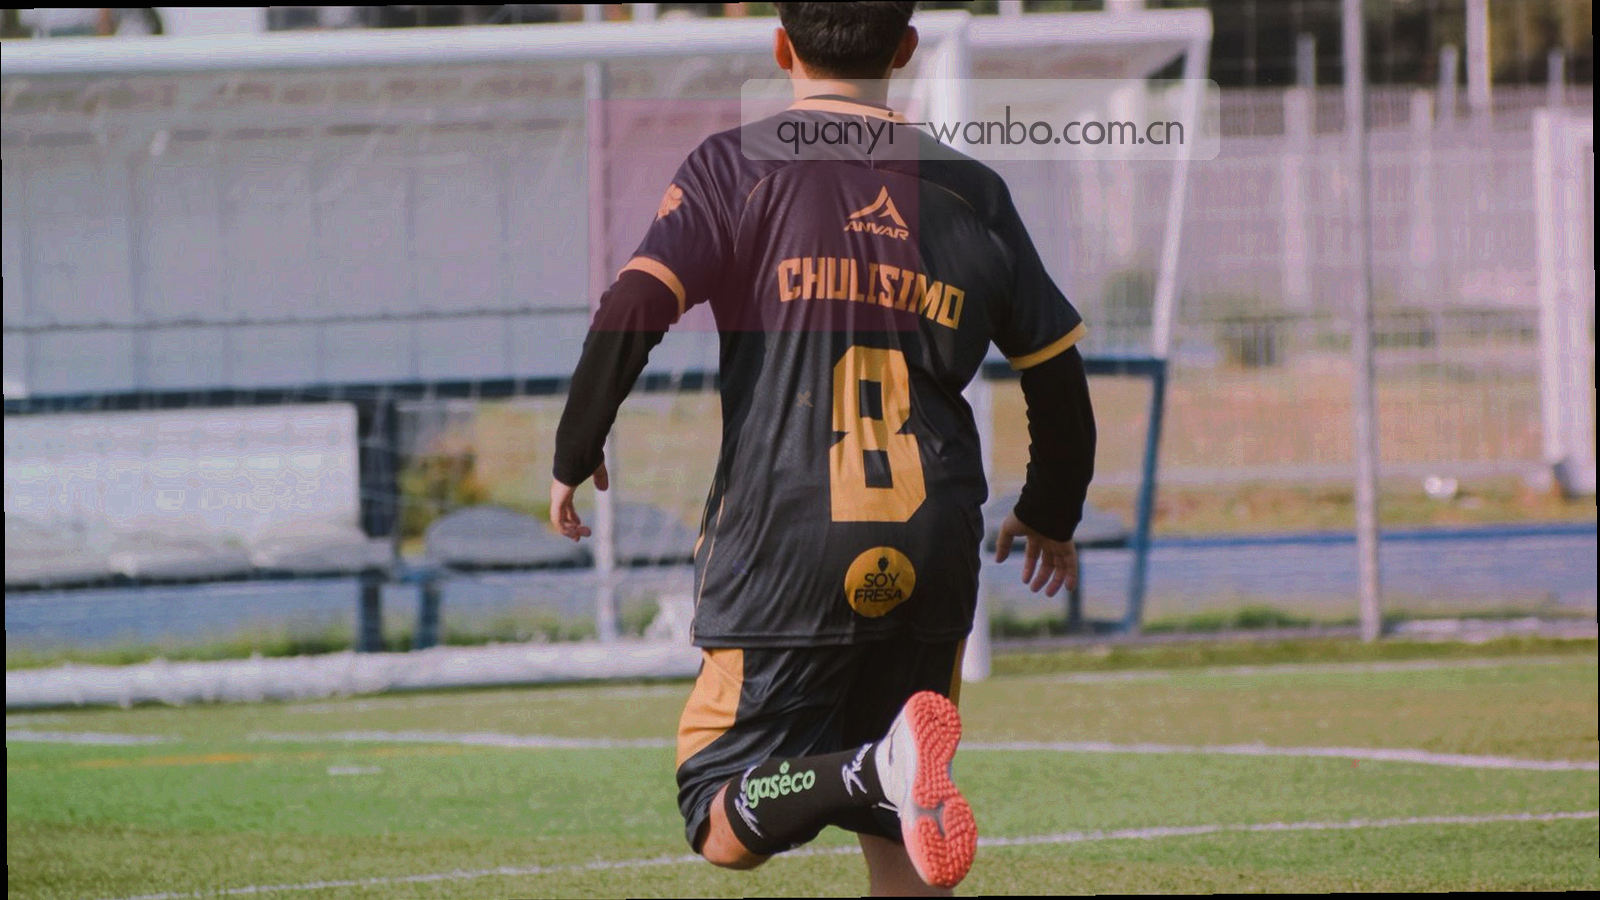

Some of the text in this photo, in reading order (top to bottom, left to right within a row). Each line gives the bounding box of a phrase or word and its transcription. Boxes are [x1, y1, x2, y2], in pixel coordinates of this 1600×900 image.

[843, 220, 909, 240] ANVAR
[777, 257, 965, 330] CHULISIMO
[829, 346, 926, 522] 8
[863, 572, 900, 588] SOY
[854, 588, 903, 603] FRESA
